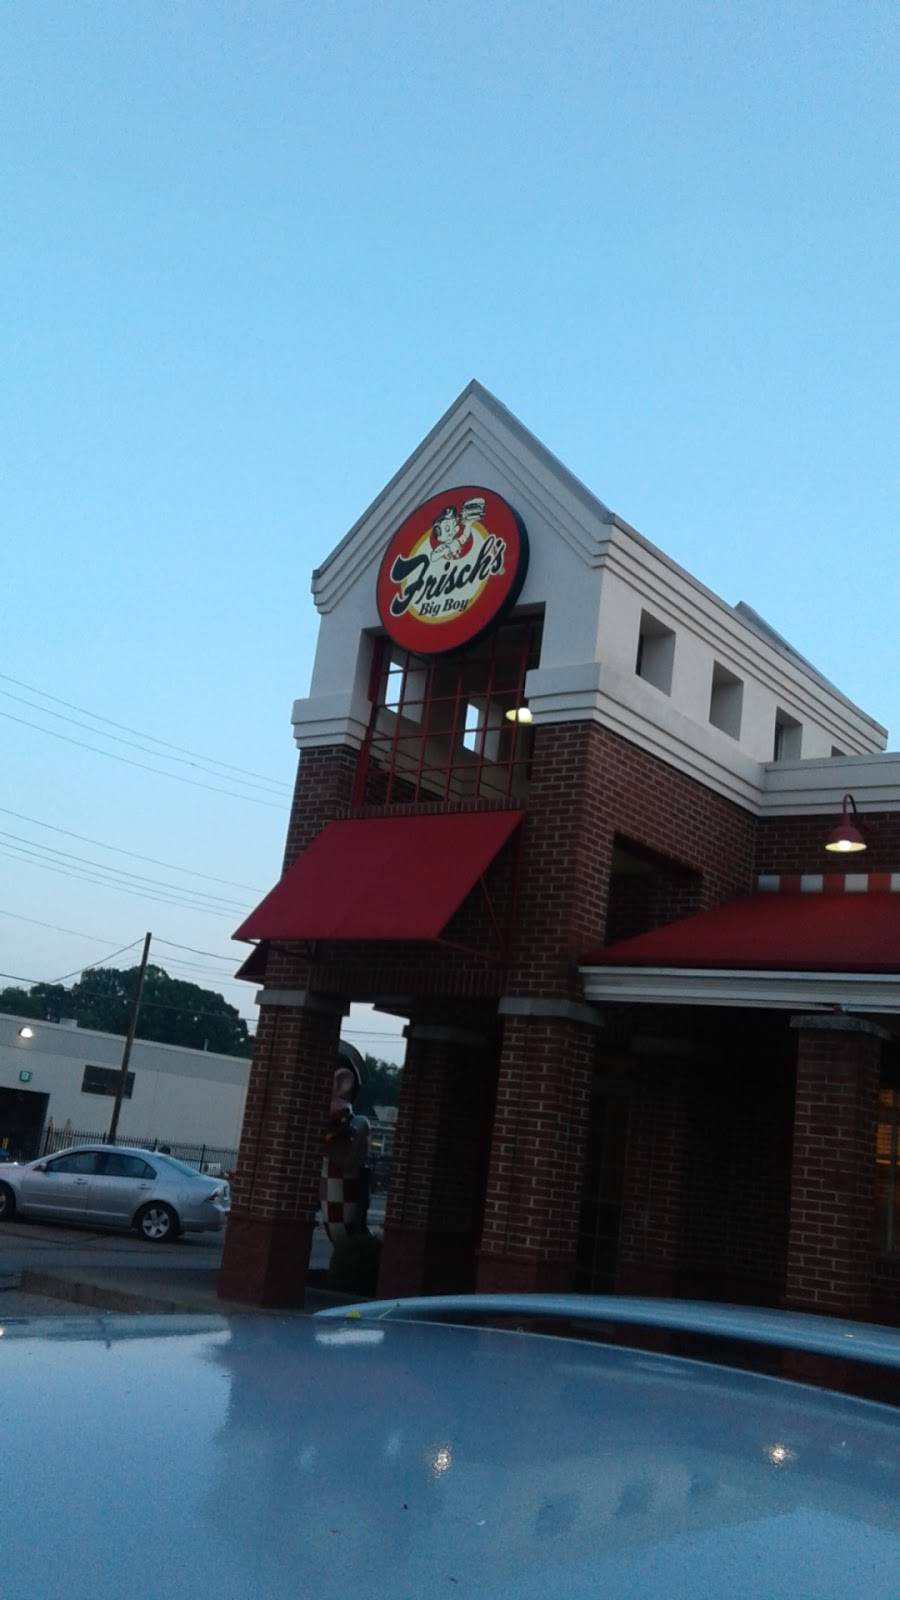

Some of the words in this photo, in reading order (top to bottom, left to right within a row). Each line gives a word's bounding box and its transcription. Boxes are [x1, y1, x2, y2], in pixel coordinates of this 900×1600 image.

[391, 535, 505, 615] Frisch's
[419, 602, 441, 616] Big
[443, 598, 469, 612] Boy
